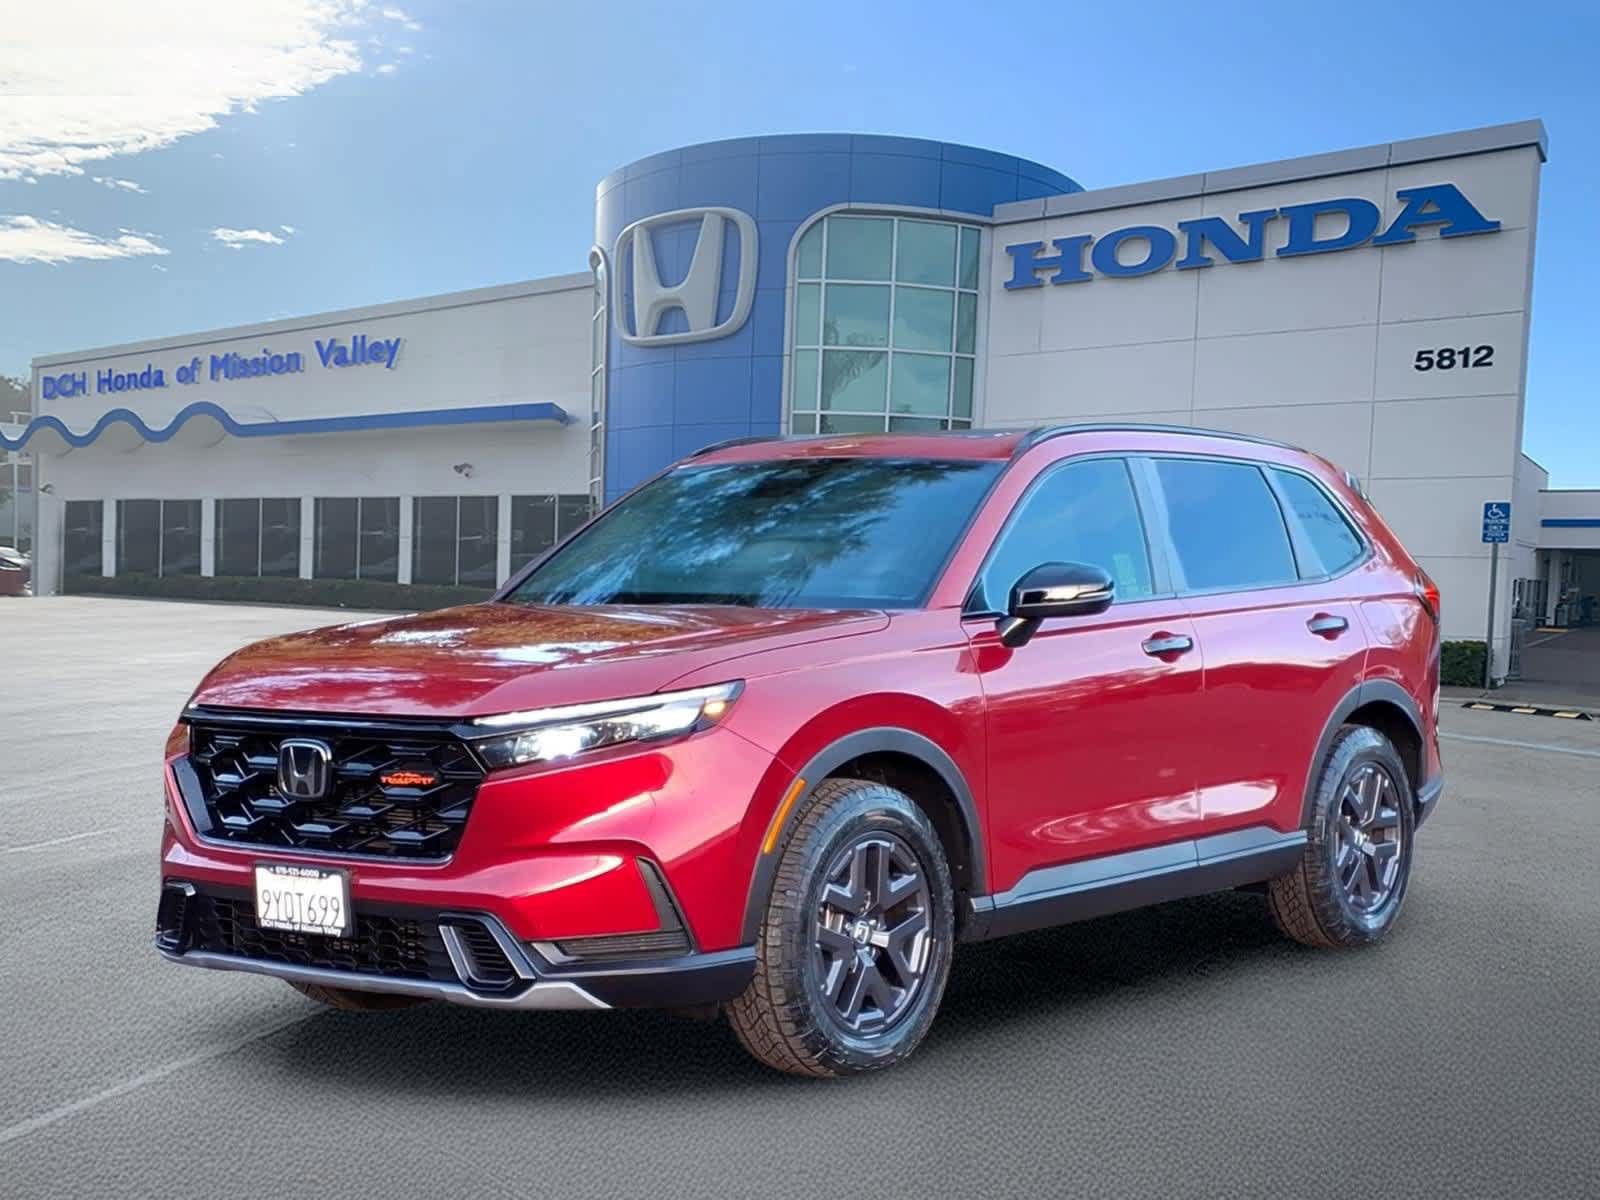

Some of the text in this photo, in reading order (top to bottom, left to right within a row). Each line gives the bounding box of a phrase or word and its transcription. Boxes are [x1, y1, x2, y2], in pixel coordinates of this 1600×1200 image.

[1003, 183, 1502, 291] HONDA
[42, 334, 402, 400] DCH Honda of Mission Valley
[1413, 344, 1494, 372] 5812
